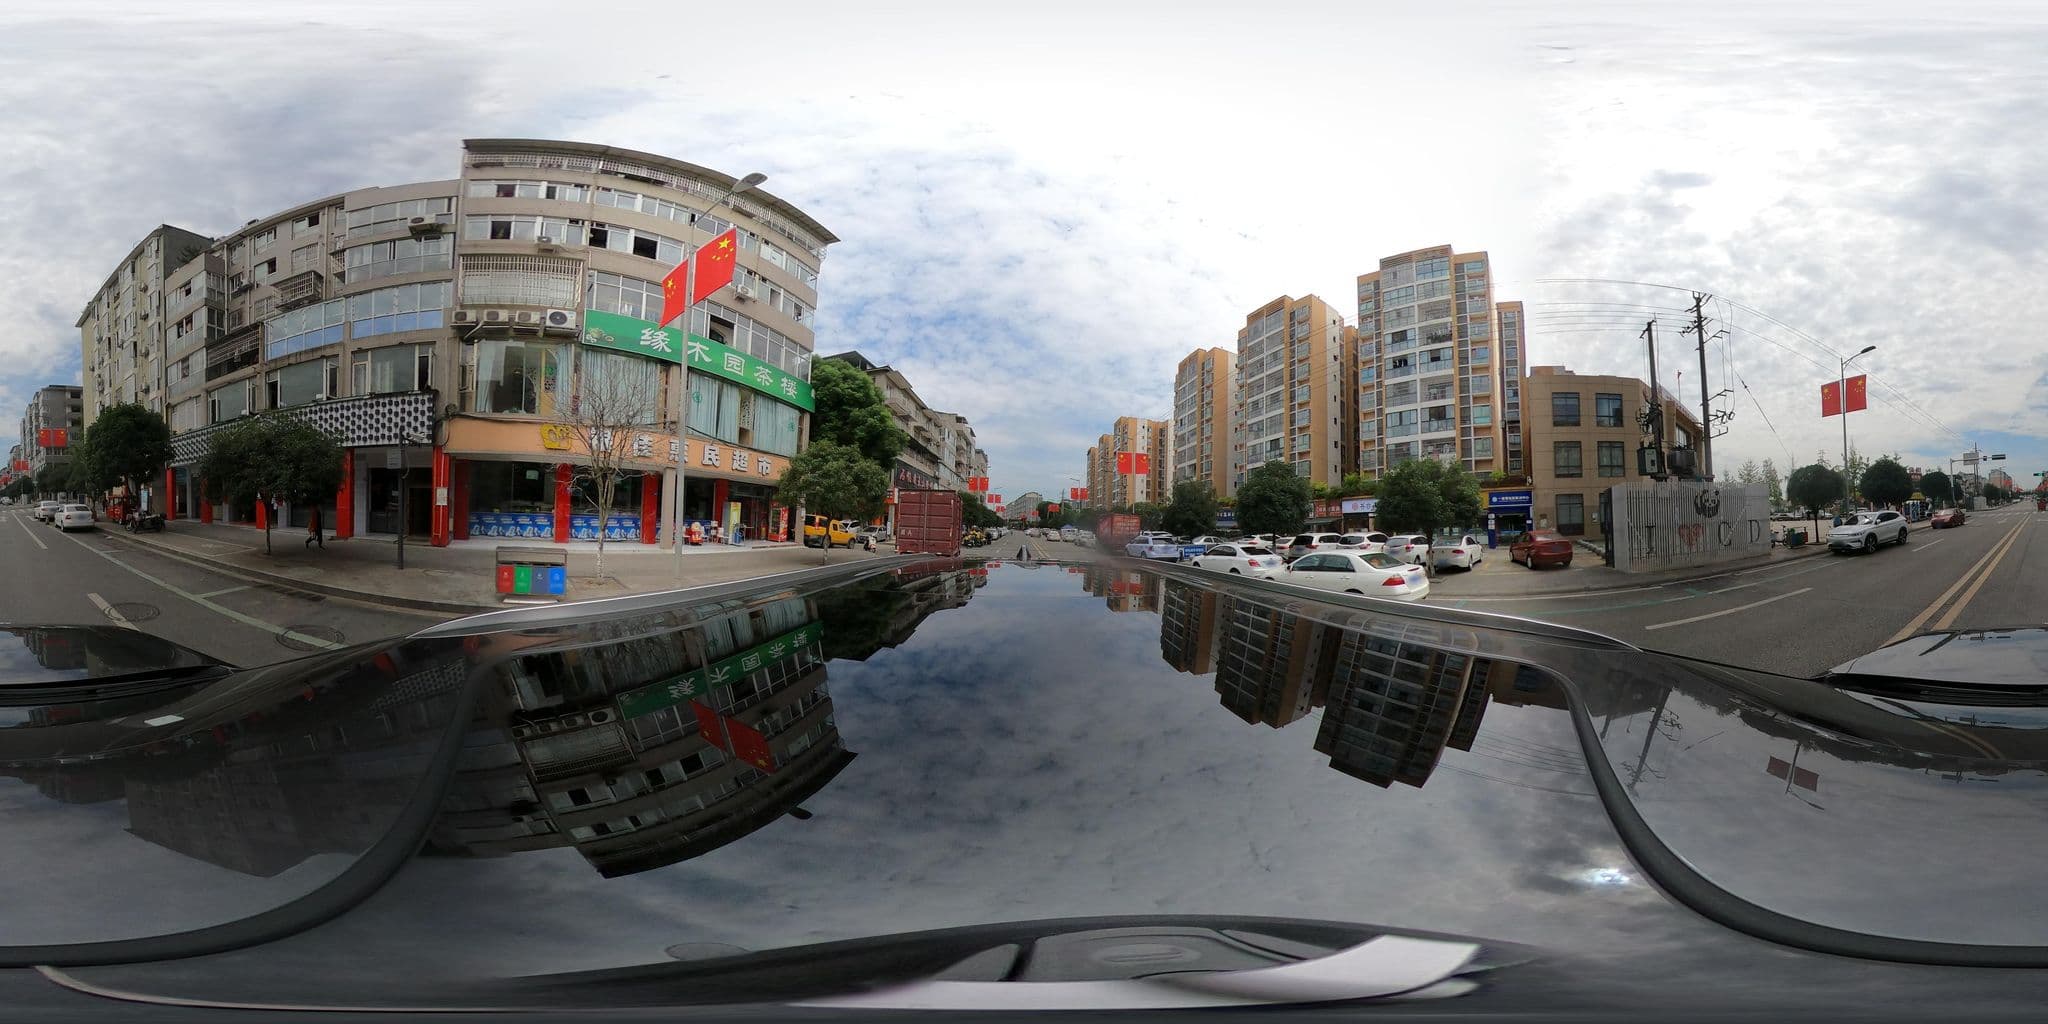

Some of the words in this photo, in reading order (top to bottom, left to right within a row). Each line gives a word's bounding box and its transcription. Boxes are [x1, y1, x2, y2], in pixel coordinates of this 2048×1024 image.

[639, 327, 799, 399] 缘木园茶楼
